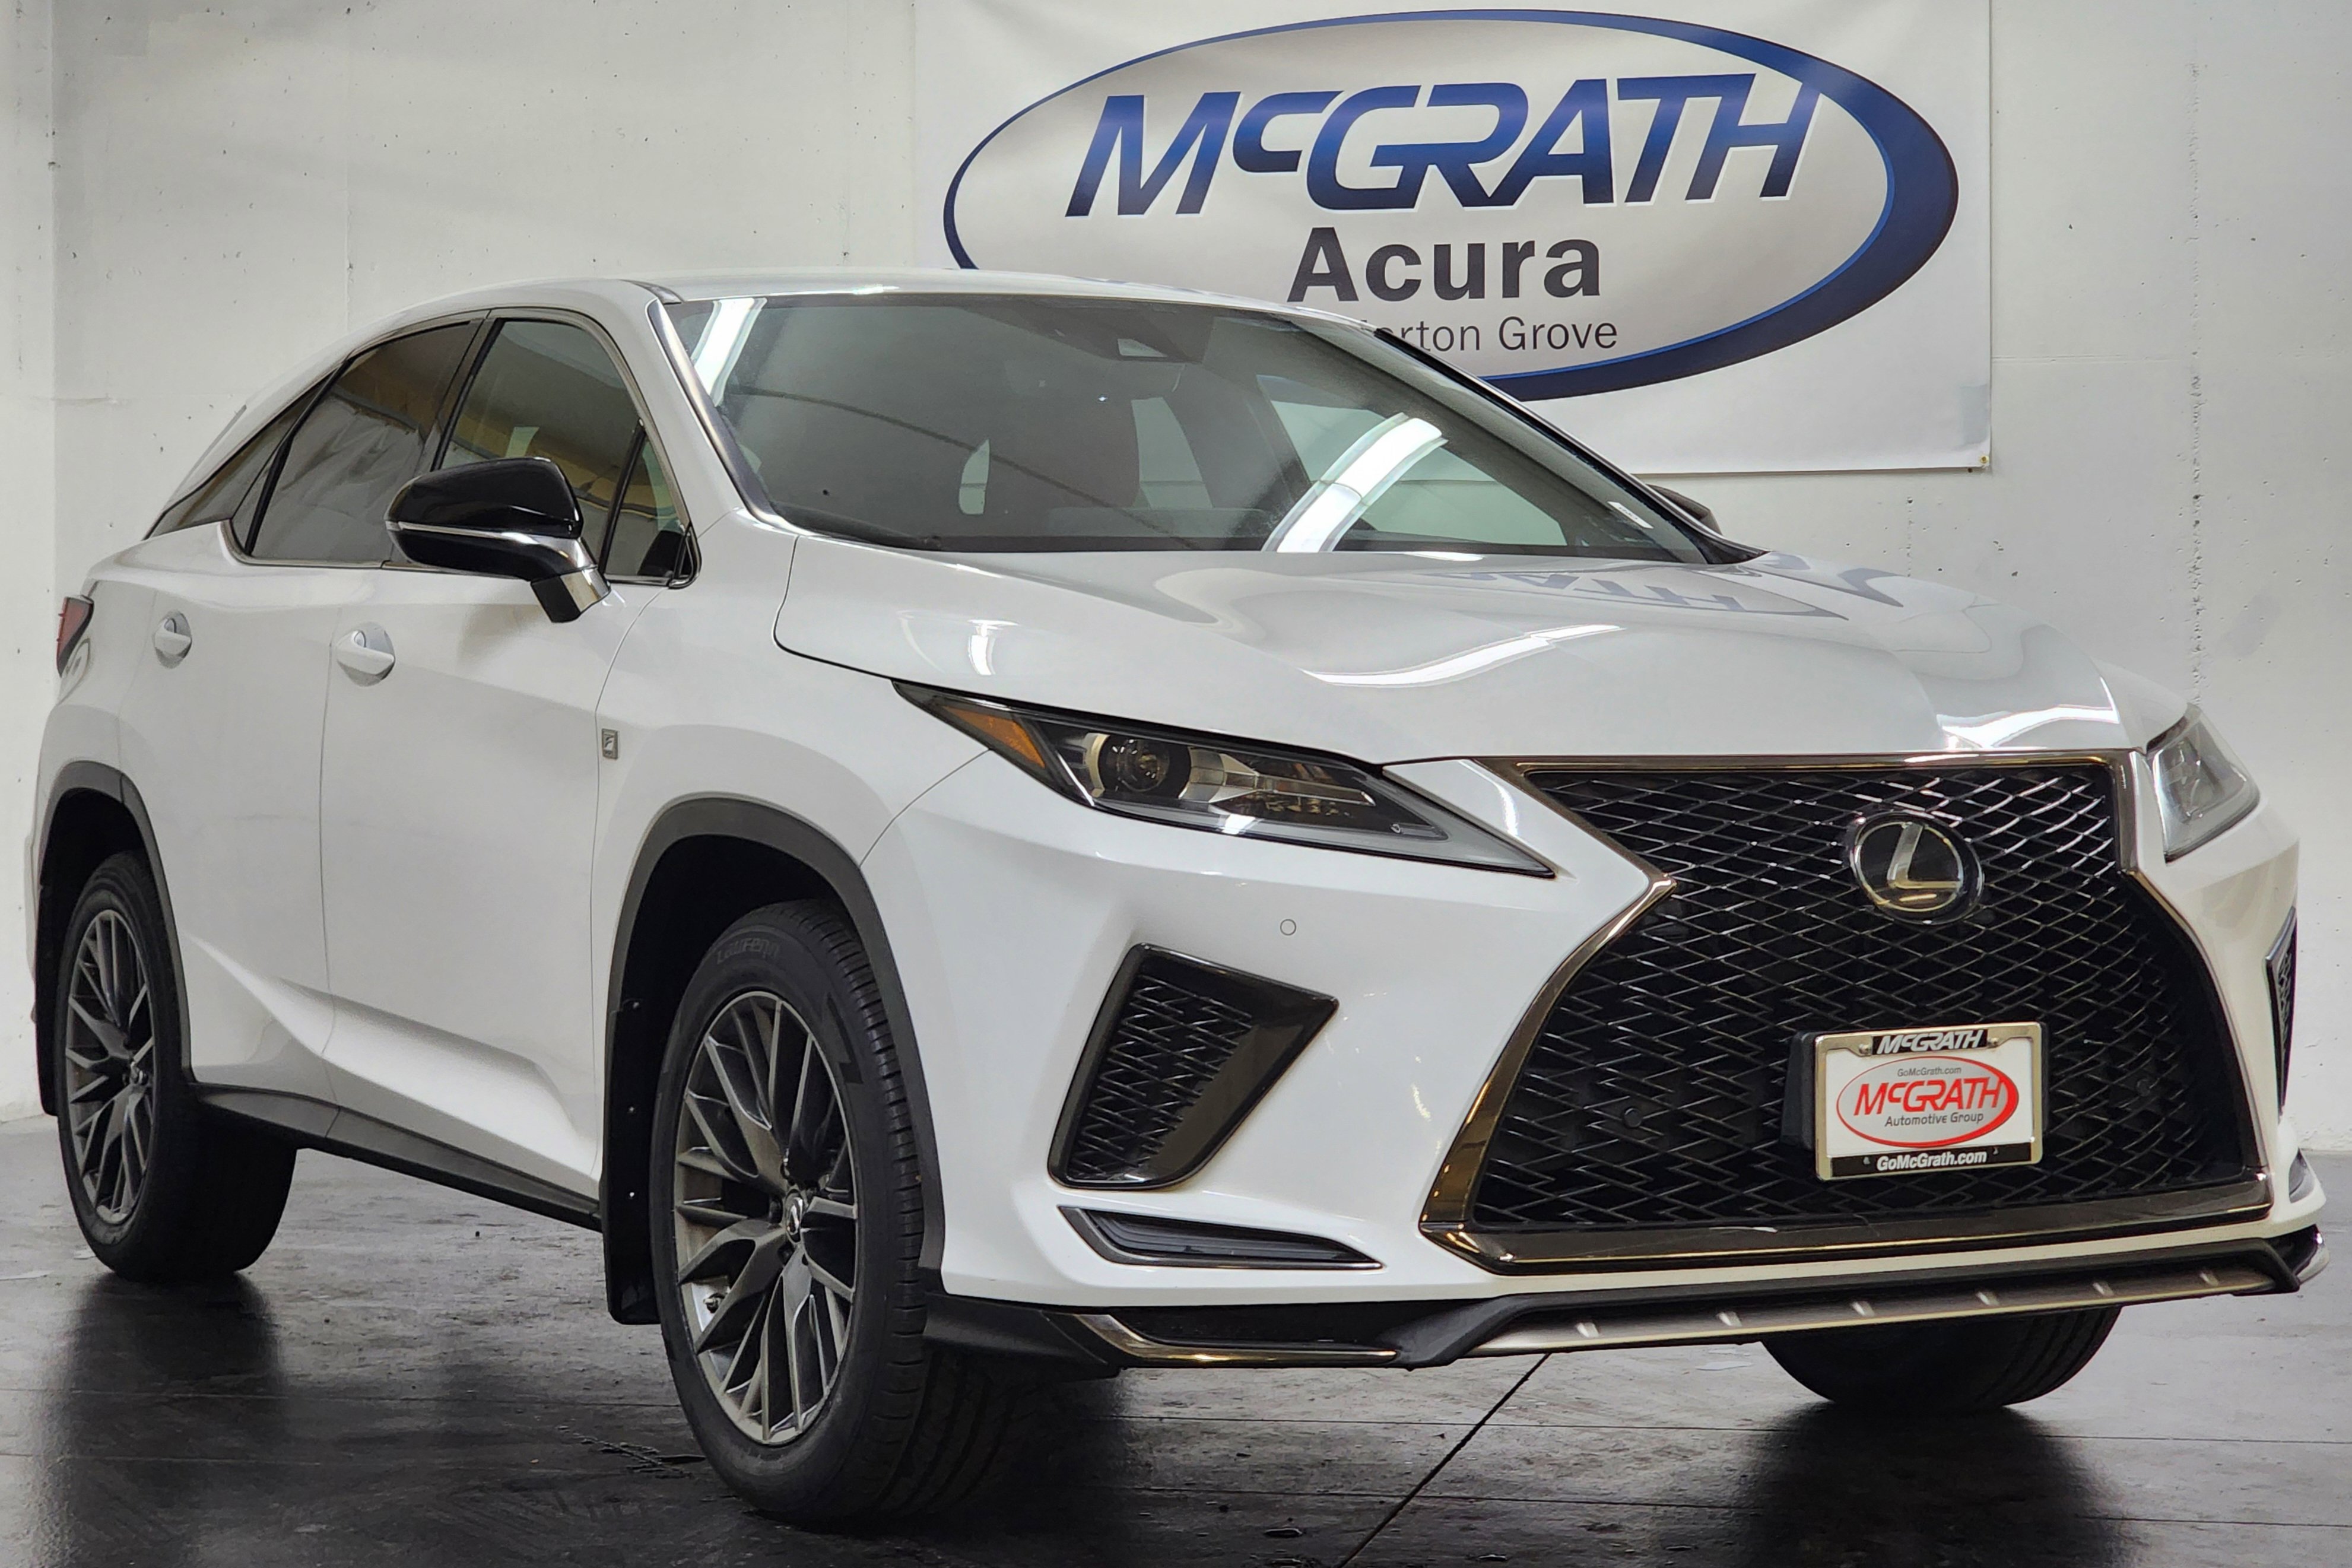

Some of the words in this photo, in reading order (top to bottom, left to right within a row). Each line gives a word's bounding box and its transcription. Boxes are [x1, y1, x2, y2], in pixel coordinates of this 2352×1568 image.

[1065, 74, 1820, 217] McGRATH
[1287, 227, 1601, 303] Acura
[1361, 319, 1480, 351] rton
[1499, 316, 1618, 351] Grove
[1897, 1067, 1962, 1077] GoMcGrath.com
[1884, 1113, 1948, 1127] Automotive
[1950, 1112, 1984, 1125] Group
[1876, 1150, 1988, 1172] GoMcGrath.com
